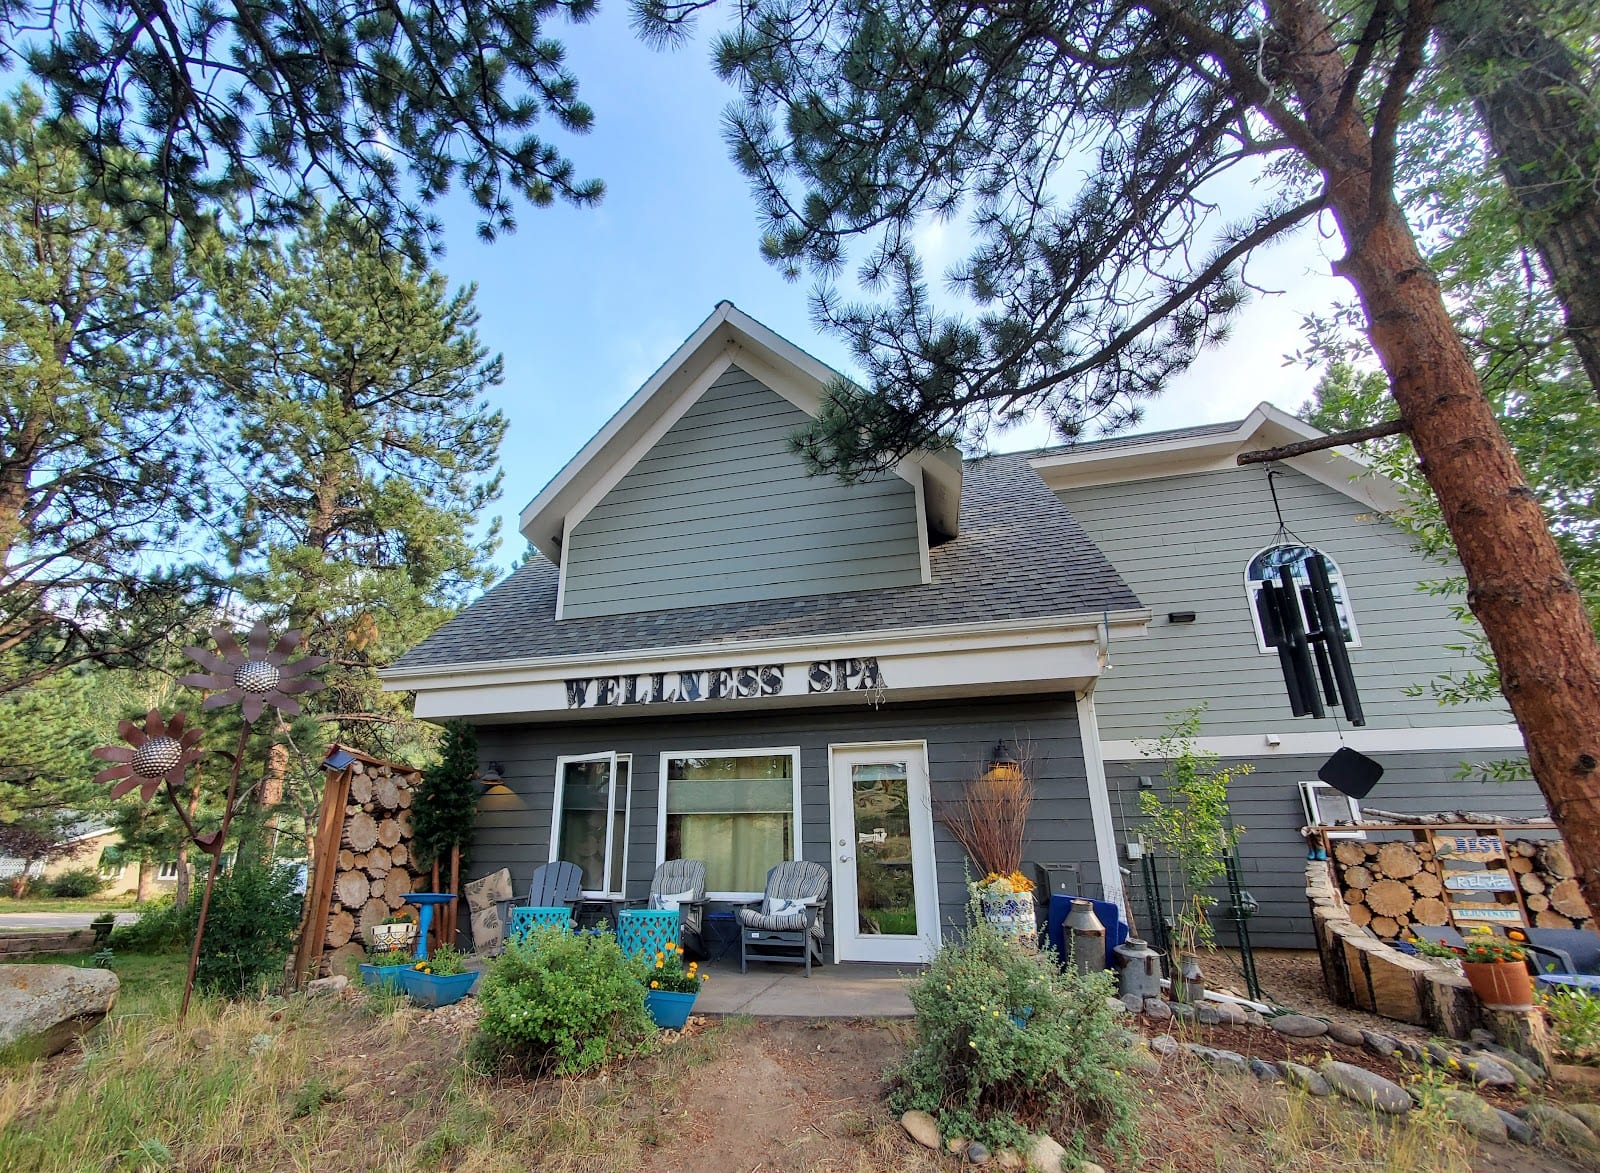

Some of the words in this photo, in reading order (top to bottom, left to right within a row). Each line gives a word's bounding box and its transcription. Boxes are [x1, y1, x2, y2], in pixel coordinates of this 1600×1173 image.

[564, 664, 784, 709] WELLNESS
[808, 656, 887, 692] SPA
[1459, 909, 1514, 918] REJUVENATE
